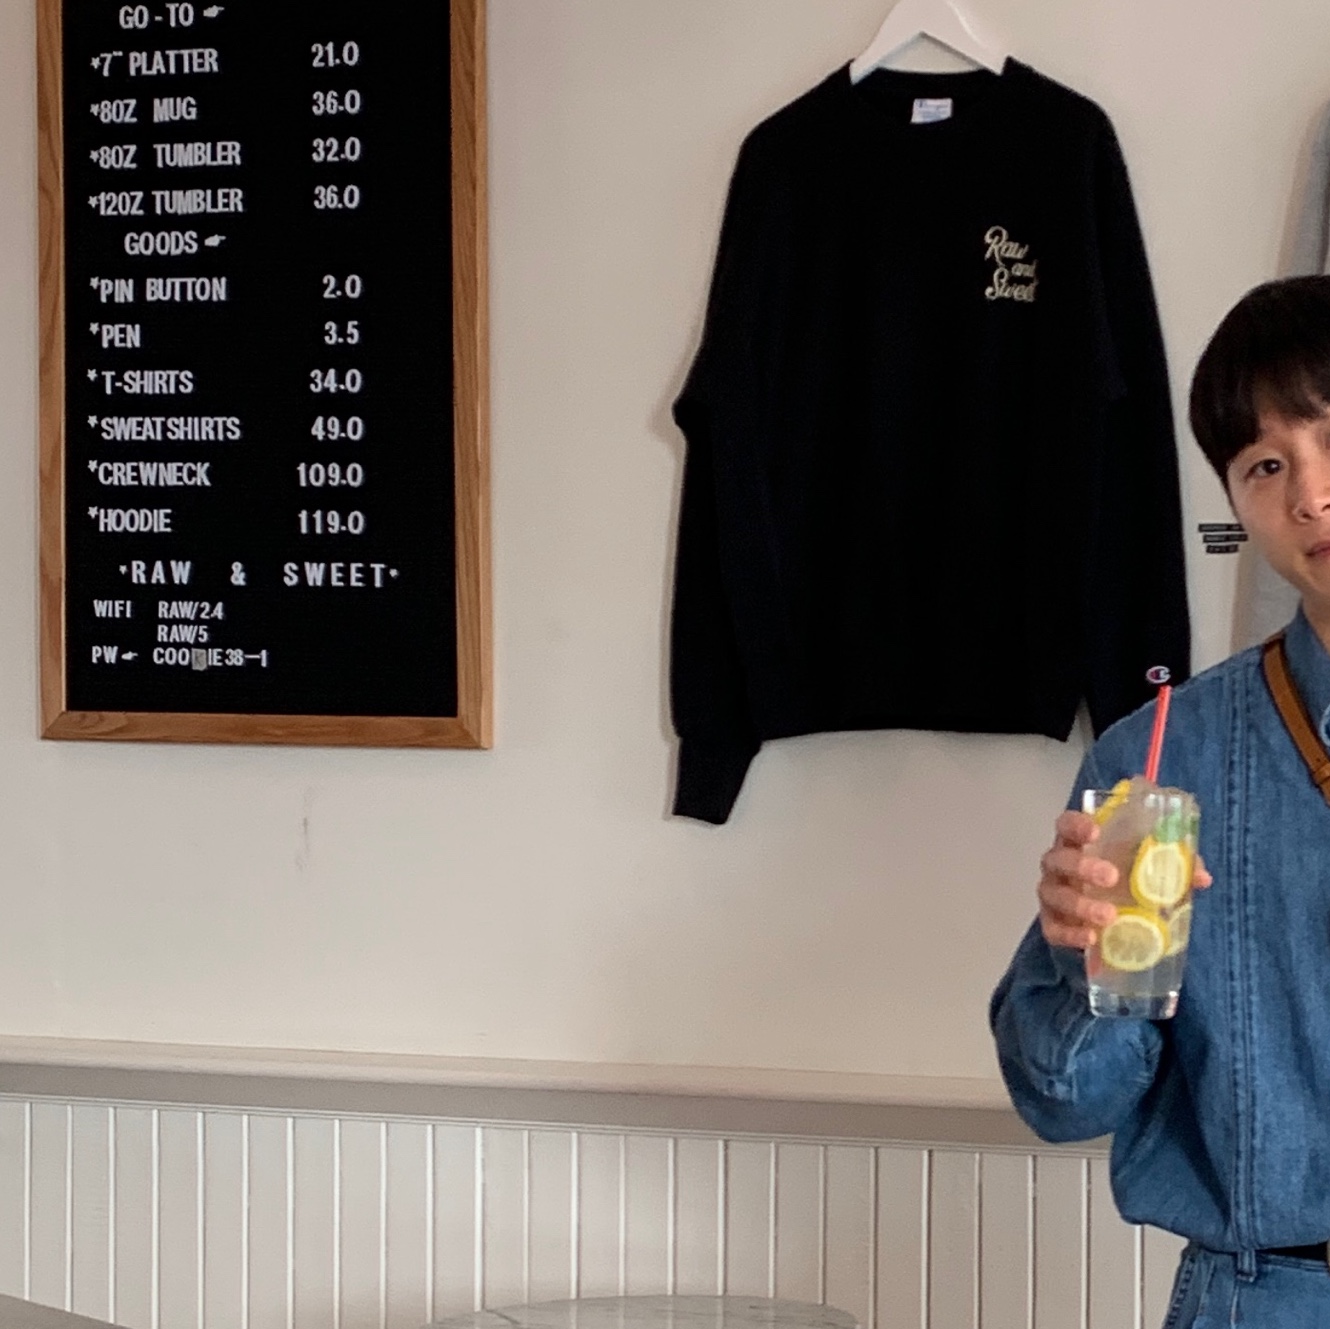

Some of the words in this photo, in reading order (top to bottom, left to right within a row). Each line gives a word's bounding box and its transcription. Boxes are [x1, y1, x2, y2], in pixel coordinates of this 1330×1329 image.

[129, 48, 219, 77] PLATTER
[311, 41, 360, 68] 21.0
[153, 97, 197, 122] MUG
[311, 89, 361, 116] 36.0
[153, 141, 242, 168] TUMBLER
[311, 136, 361, 163] 32.0
[152, 188, 244, 216] TUMBLER
[313, 184, 360, 210] 36.0
[124, 231, 198, 256] GOODS
[984, 226, 1029, 268] Raw
[1011, 259, 1039, 278] and
[100, 279, 134, 303] PIN
[145, 276, 227, 302] BUTTON
[322, 274, 362, 299] 2.0
[984, 266, 1039, 303] Sweet
[101, 324, 141, 348] PEN
[324, 321, 360, 345] 3.5
[102, 370, 194, 395] T-SHIRTS
[309, 368, 362, 393] 34.0
[310, 415, 364, 441] 49.0
[98, 462, 212, 487] CREWNECK
[296, 462, 364, 488] 109.0
[98, 507, 172, 533] HOODIE
[298, 509, 365, 535] 119.0
[131, 560, 192, 585] RAW
[230, 562, 247, 586] &
[283, 562, 386, 588] SWEET
[93, 599, 132, 619] WIFI
[157, 623, 209, 645] RAW/5
[91, 646, 118, 664] PW
